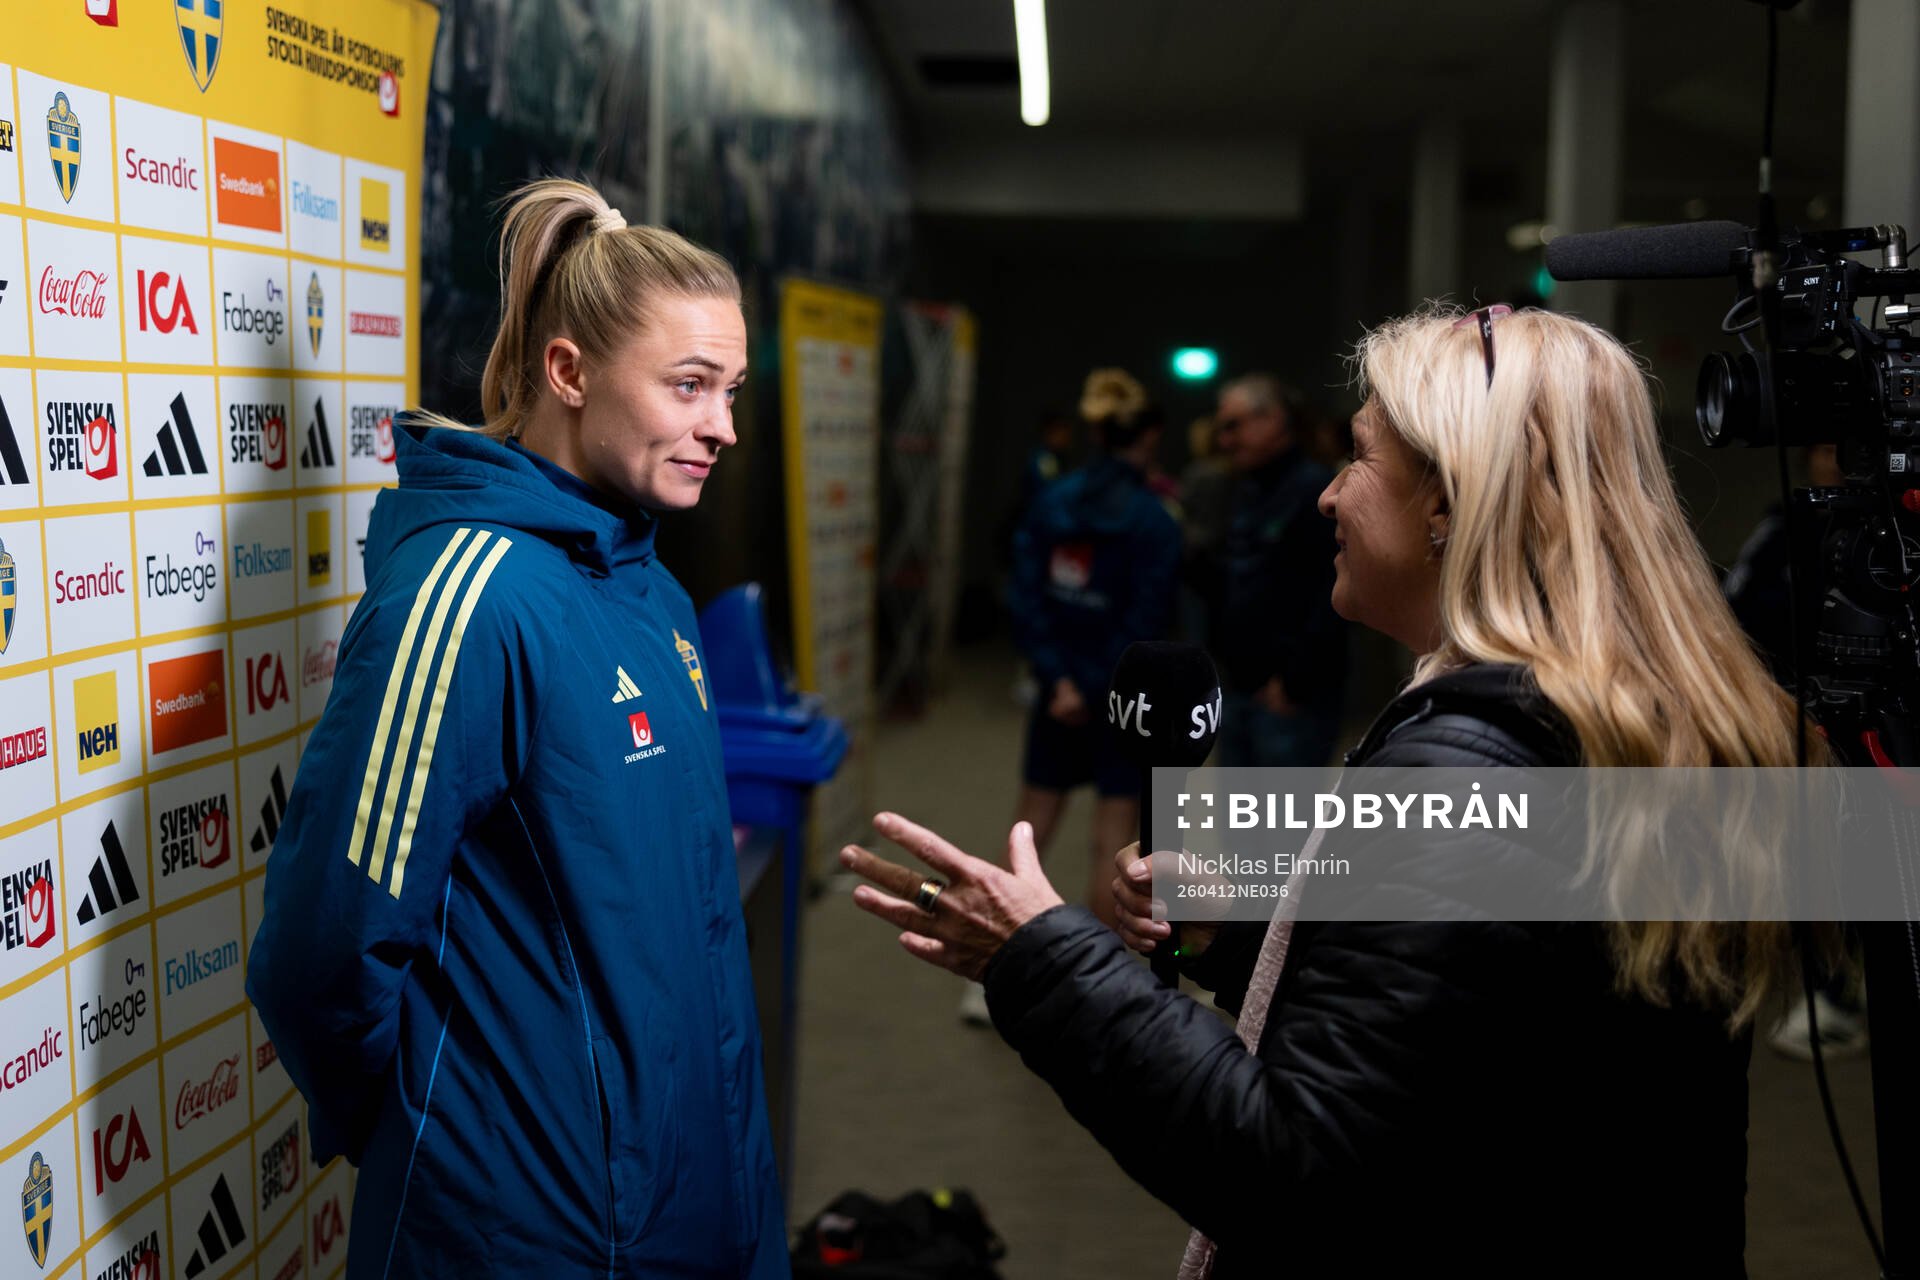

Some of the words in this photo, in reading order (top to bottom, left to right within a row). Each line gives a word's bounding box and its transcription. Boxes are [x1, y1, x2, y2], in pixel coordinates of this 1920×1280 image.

[51, 122, 76, 135] SVERIGE
[126, 148, 198, 191] Scandic
[219, 172, 265, 198] Swedbank
[292, 181, 338, 222] Folksam
[39, 264, 109, 320] Coca-Cola
[137, 269, 199, 335] ICA
[223, 292, 284, 346] Fabege
[47, 401, 117, 436] SVENSKA
[229, 404, 287, 432] SVENSKA
[49, 437, 84, 472] SPEL
[231, 435, 263, 463] SPEL
[351, 434, 376, 457] SPEL
[146, 555, 216, 603] Fabege
[234, 543, 292, 578] Folksam
[55, 562, 125, 604] Scandic
[155, 688, 206, 717] Swedbank
[246, 651, 289, 715] ICA
[1109, 690, 1152, 737] svt
[624, 749, 652, 764] SVENSKA
[652, 745, 666, 756] SPEL
[159, 793, 230, 844] SVENSKA
[162, 842, 198, 877] SPEL
[164, 939, 239, 997] Folksam
[79, 988, 146, 1050] Fabege
[0, 1026, 62, 1093] candic
[175, 1051, 241, 1130] Coca-Cola
[93, 1105, 151, 1197] ICA
[313, 1193, 345, 1267] ICA
